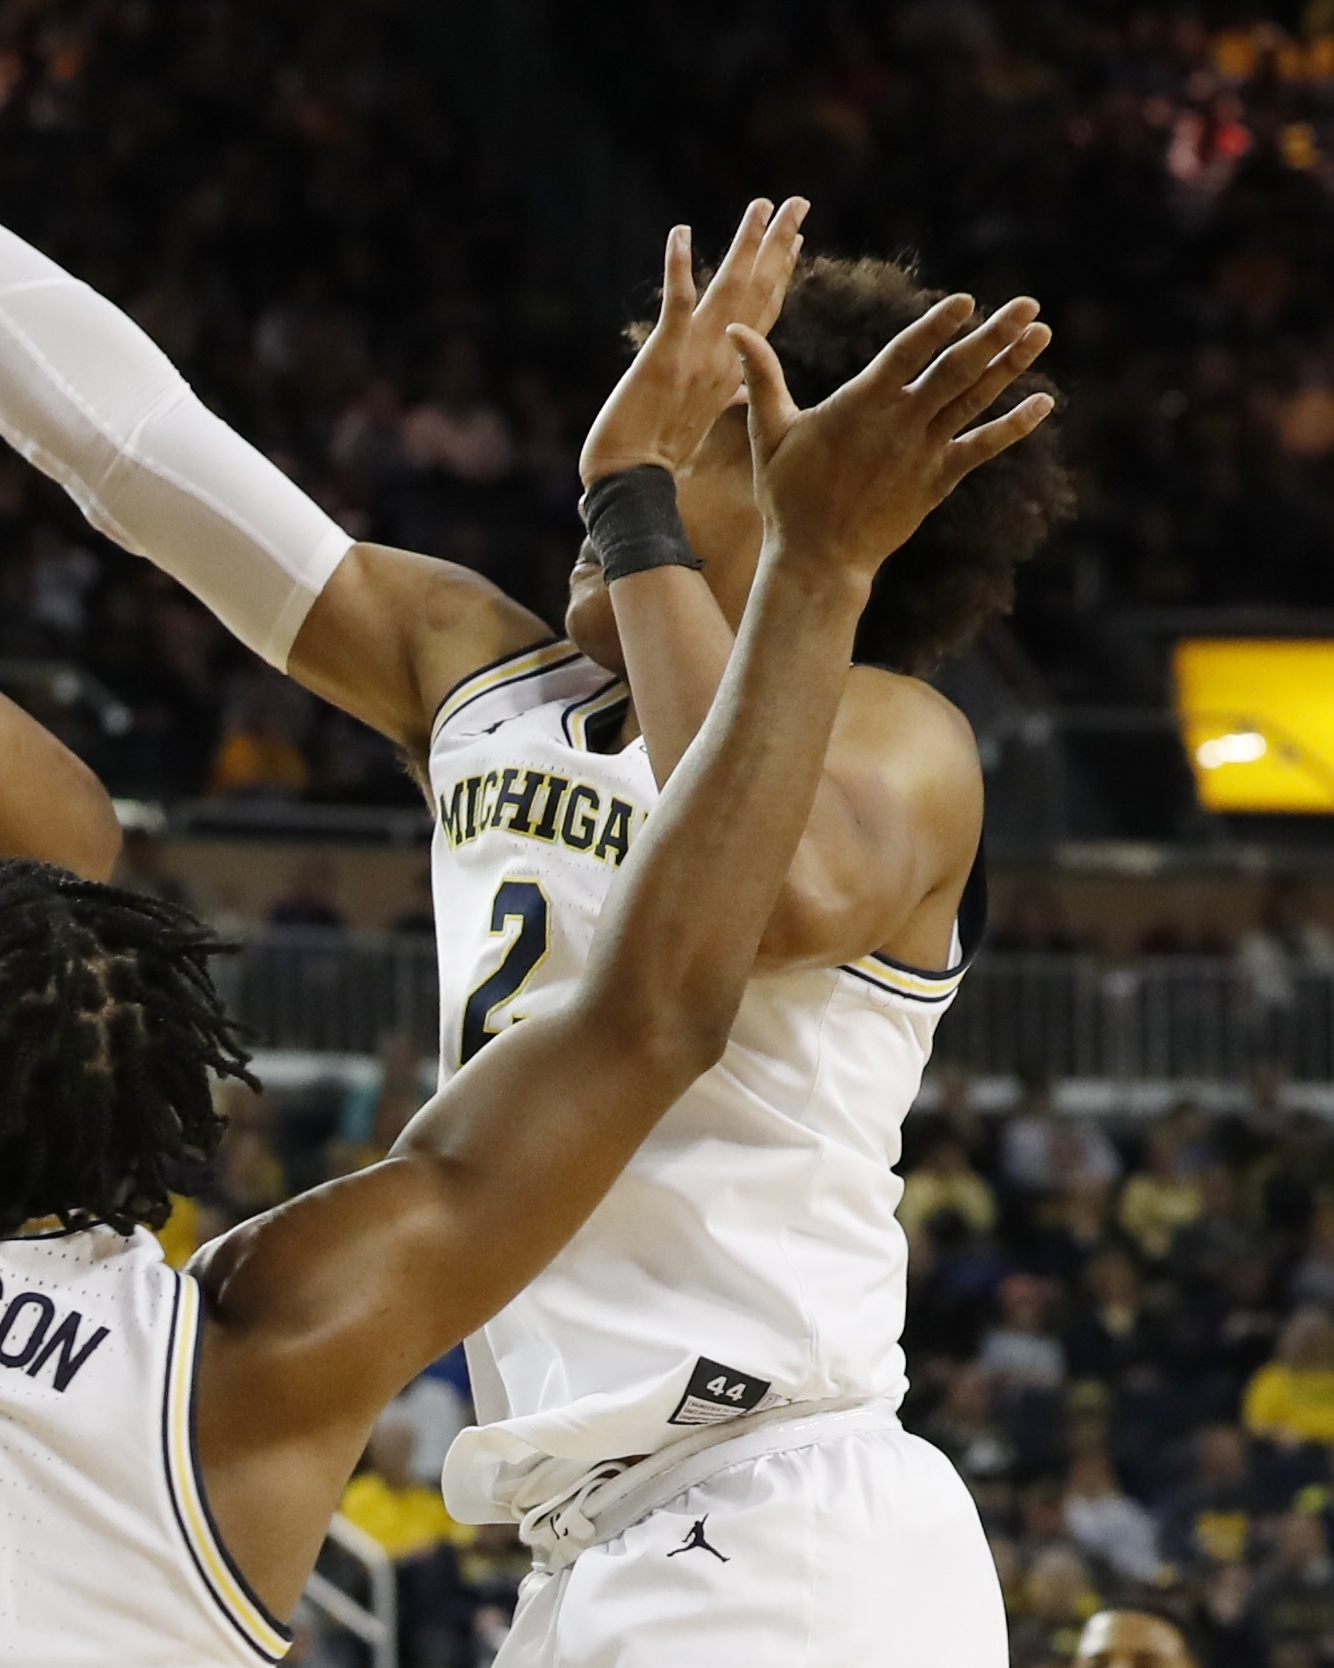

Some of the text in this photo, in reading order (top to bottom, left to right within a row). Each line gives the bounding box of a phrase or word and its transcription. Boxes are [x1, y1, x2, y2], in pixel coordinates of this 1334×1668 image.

[439, 768, 650, 868] MICHIGA
[459, 876, 550, 1067] 2
[706, 1375, 747, 1401] 44
